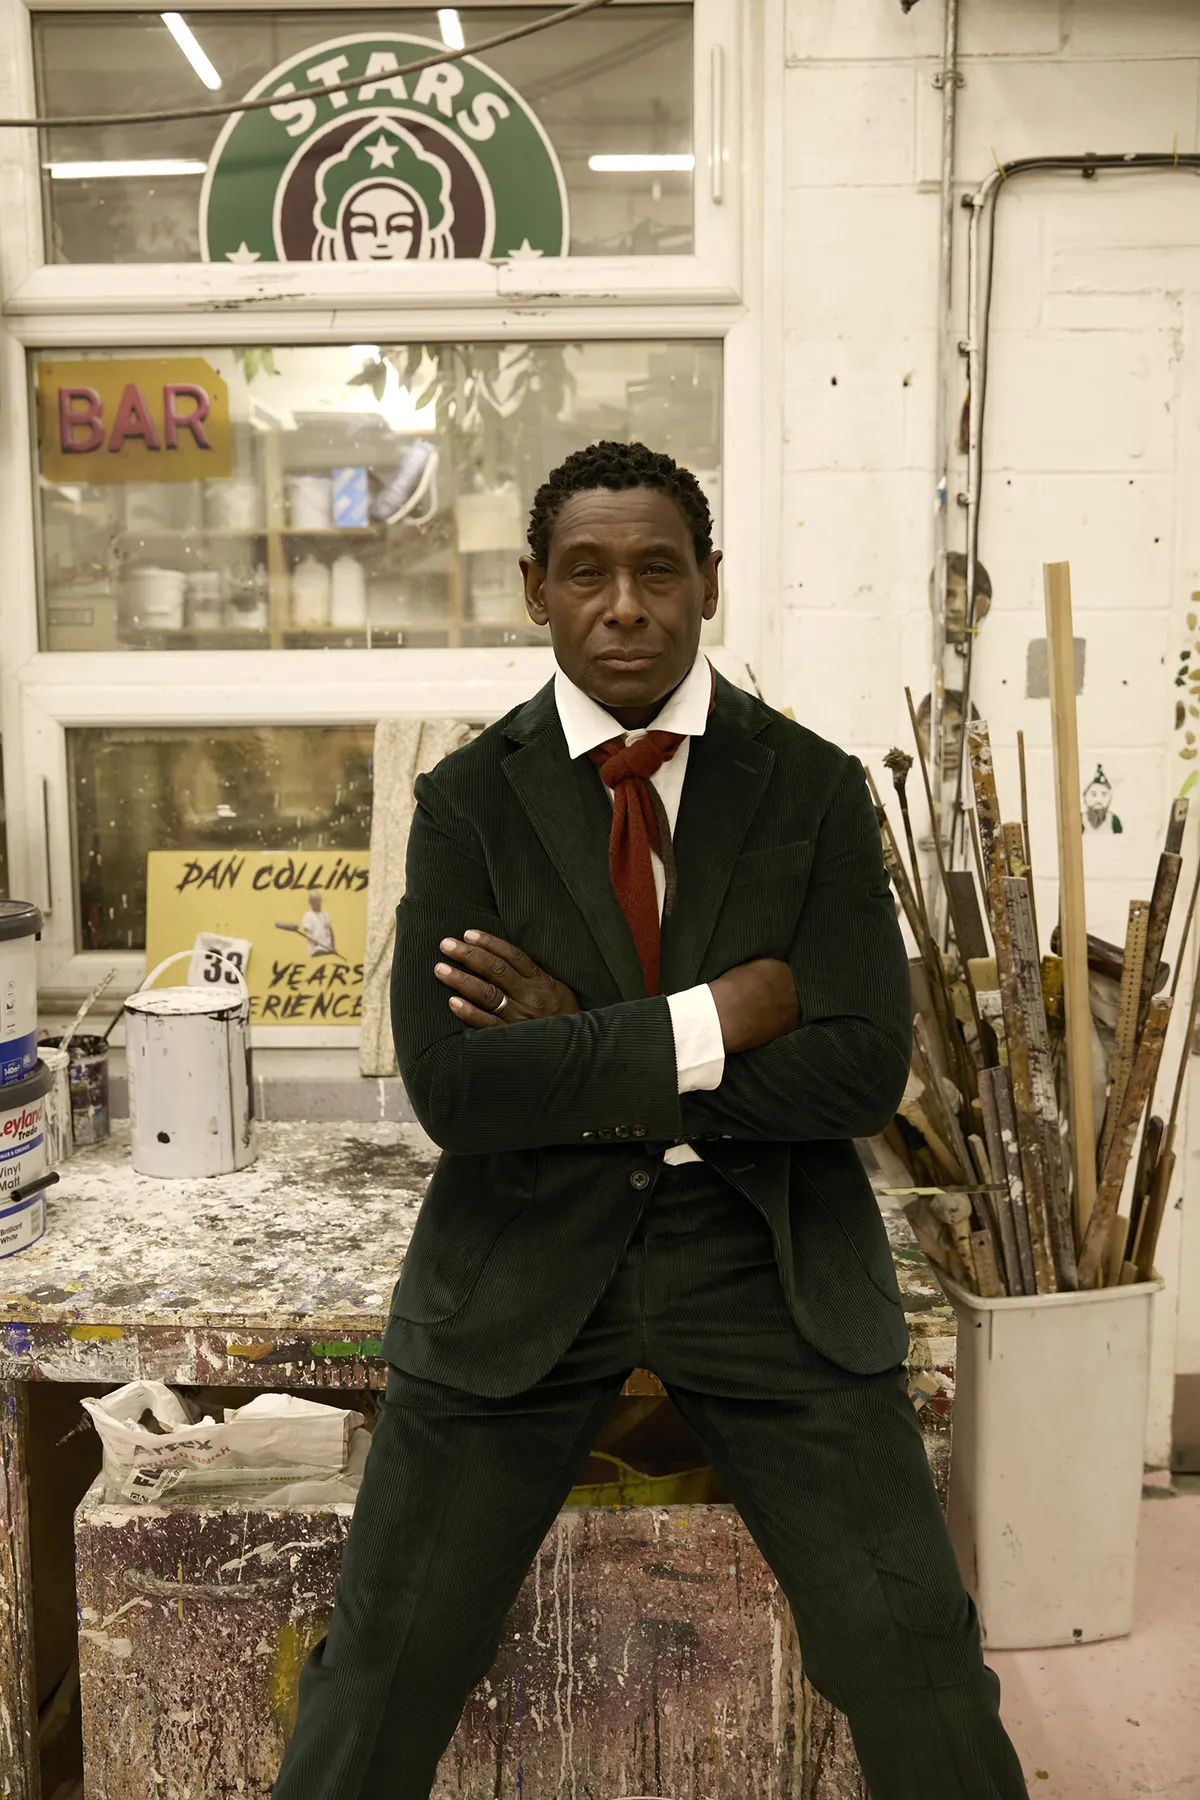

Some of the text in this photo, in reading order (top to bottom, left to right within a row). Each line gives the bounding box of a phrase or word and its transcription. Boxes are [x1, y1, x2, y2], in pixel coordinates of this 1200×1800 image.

[269, 51, 511, 141] STARS
[58, 382, 212, 454] BAR
[176, 855, 247, 894] DAN
[203, 949, 244, 984] 33
[268, 960, 364, 992] YEARS
[0, 1100, 43, 1139] eyland
[18, 1125, 38, 1141] Trade
[0, 1221, 23, 1237] Brilliant
